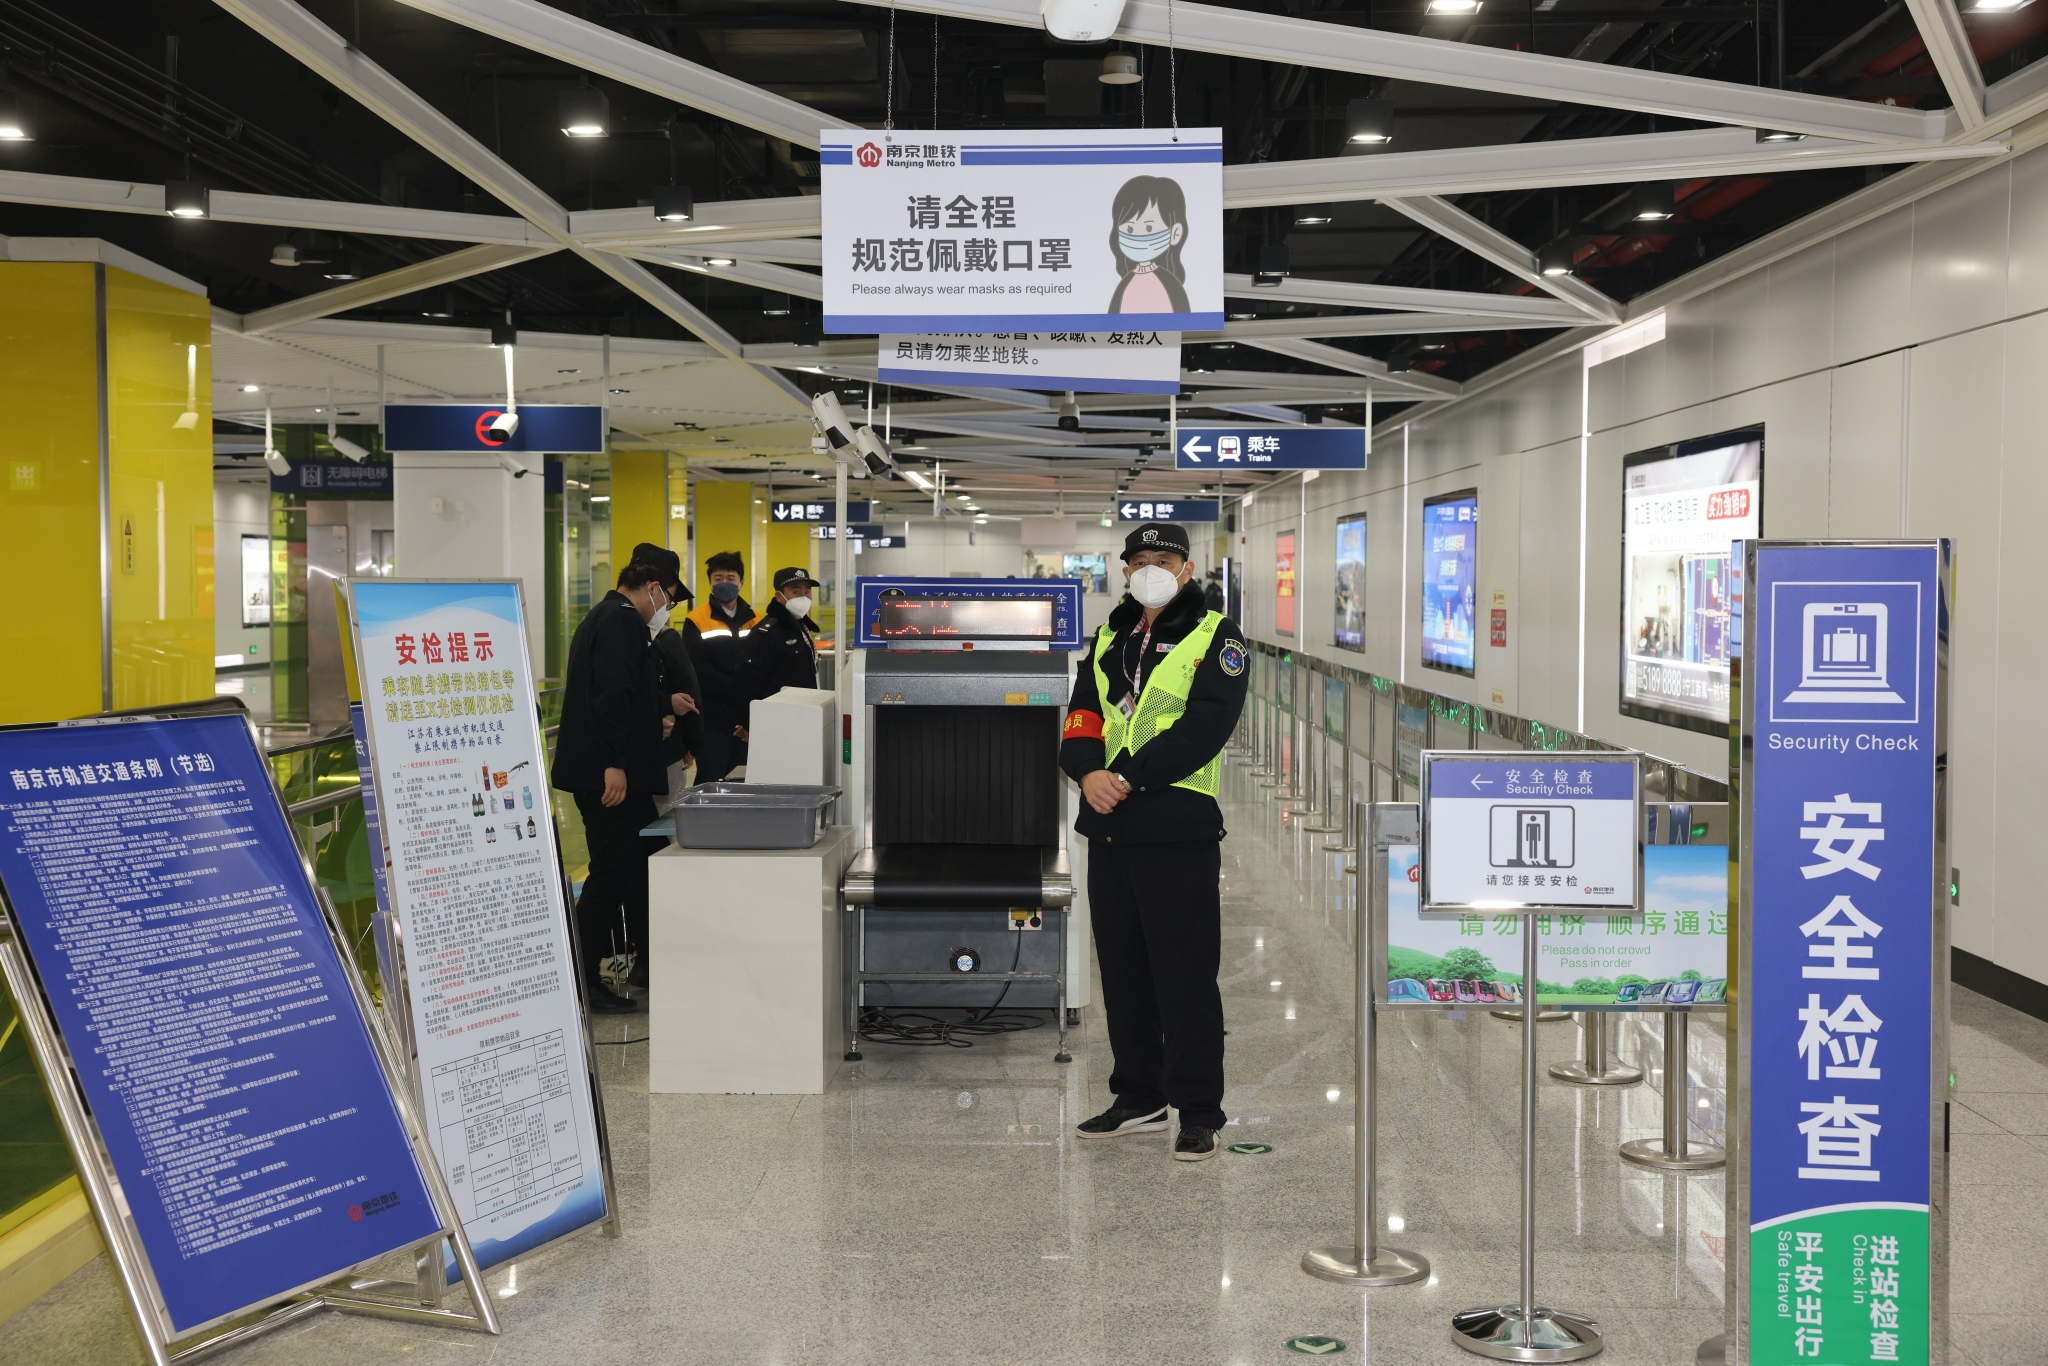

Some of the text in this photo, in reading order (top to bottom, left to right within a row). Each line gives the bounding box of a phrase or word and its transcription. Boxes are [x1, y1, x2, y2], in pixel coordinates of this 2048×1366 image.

[886, 144, 956, 160] 南京地铁
[886, 158, 956, 169] Nanjing Metro
[906, 195, 1016, 230] 请全程
[852, 238, 1072, 273] 规范佩戴口罩
[852, 282, 1072, 297] Please always wear masks as required
[896, 341, 1039, 365] 员请勿乘坐地铁。
[1248, 436, 1280, 453] 乘车
[1248, 454, 1272, 462] Trains
[327, 466, 388, 479] 无障碍电梯
[806, 505, 824, 515] 乘车
[1156, 504, 1174, 514] 乘车
[1708, 490, 1747, 518] 实力劲销中
[395, 632, 494, 666] 安检提示
[382, 669, 515, 698] 乘客随身携带的箱包等
[1643, 665, 1661, 692] 5189
[1662, 668, 1682, 697] 8888
[385, 693, 515, 722] 请送至X光检测仪机检
[408, 719, 505, 740] 江苏省乘坐城市轨道交通
[414, 734, 502, 754] 禁止限制携带物品目录
[1769, 733, 1919, 754] Security Check
[1505, 768, 1593, 785] 安全检查
[1506, 784, 1594, 797] Security Check
[1486, 874, 1579, 887] 请您接受安检
[1606, 910, 1728, 937] 顺序通过
[1542, 944, 1651, 956] Please do not crowd
[1560, 958, 1632, 968] Pass in order
[1798, 793, 1885, 1182] 安全检查
[362, 1191, 399, 1211] 南京地铁
[1777, 1230, 1792, 1318] Safe travel
[1852, 1234, 1868, 1305] Check in
[1794, 1231, 1824, 1358] 平安出行
[1869, 1235, 1900, 1362] 进站检查
